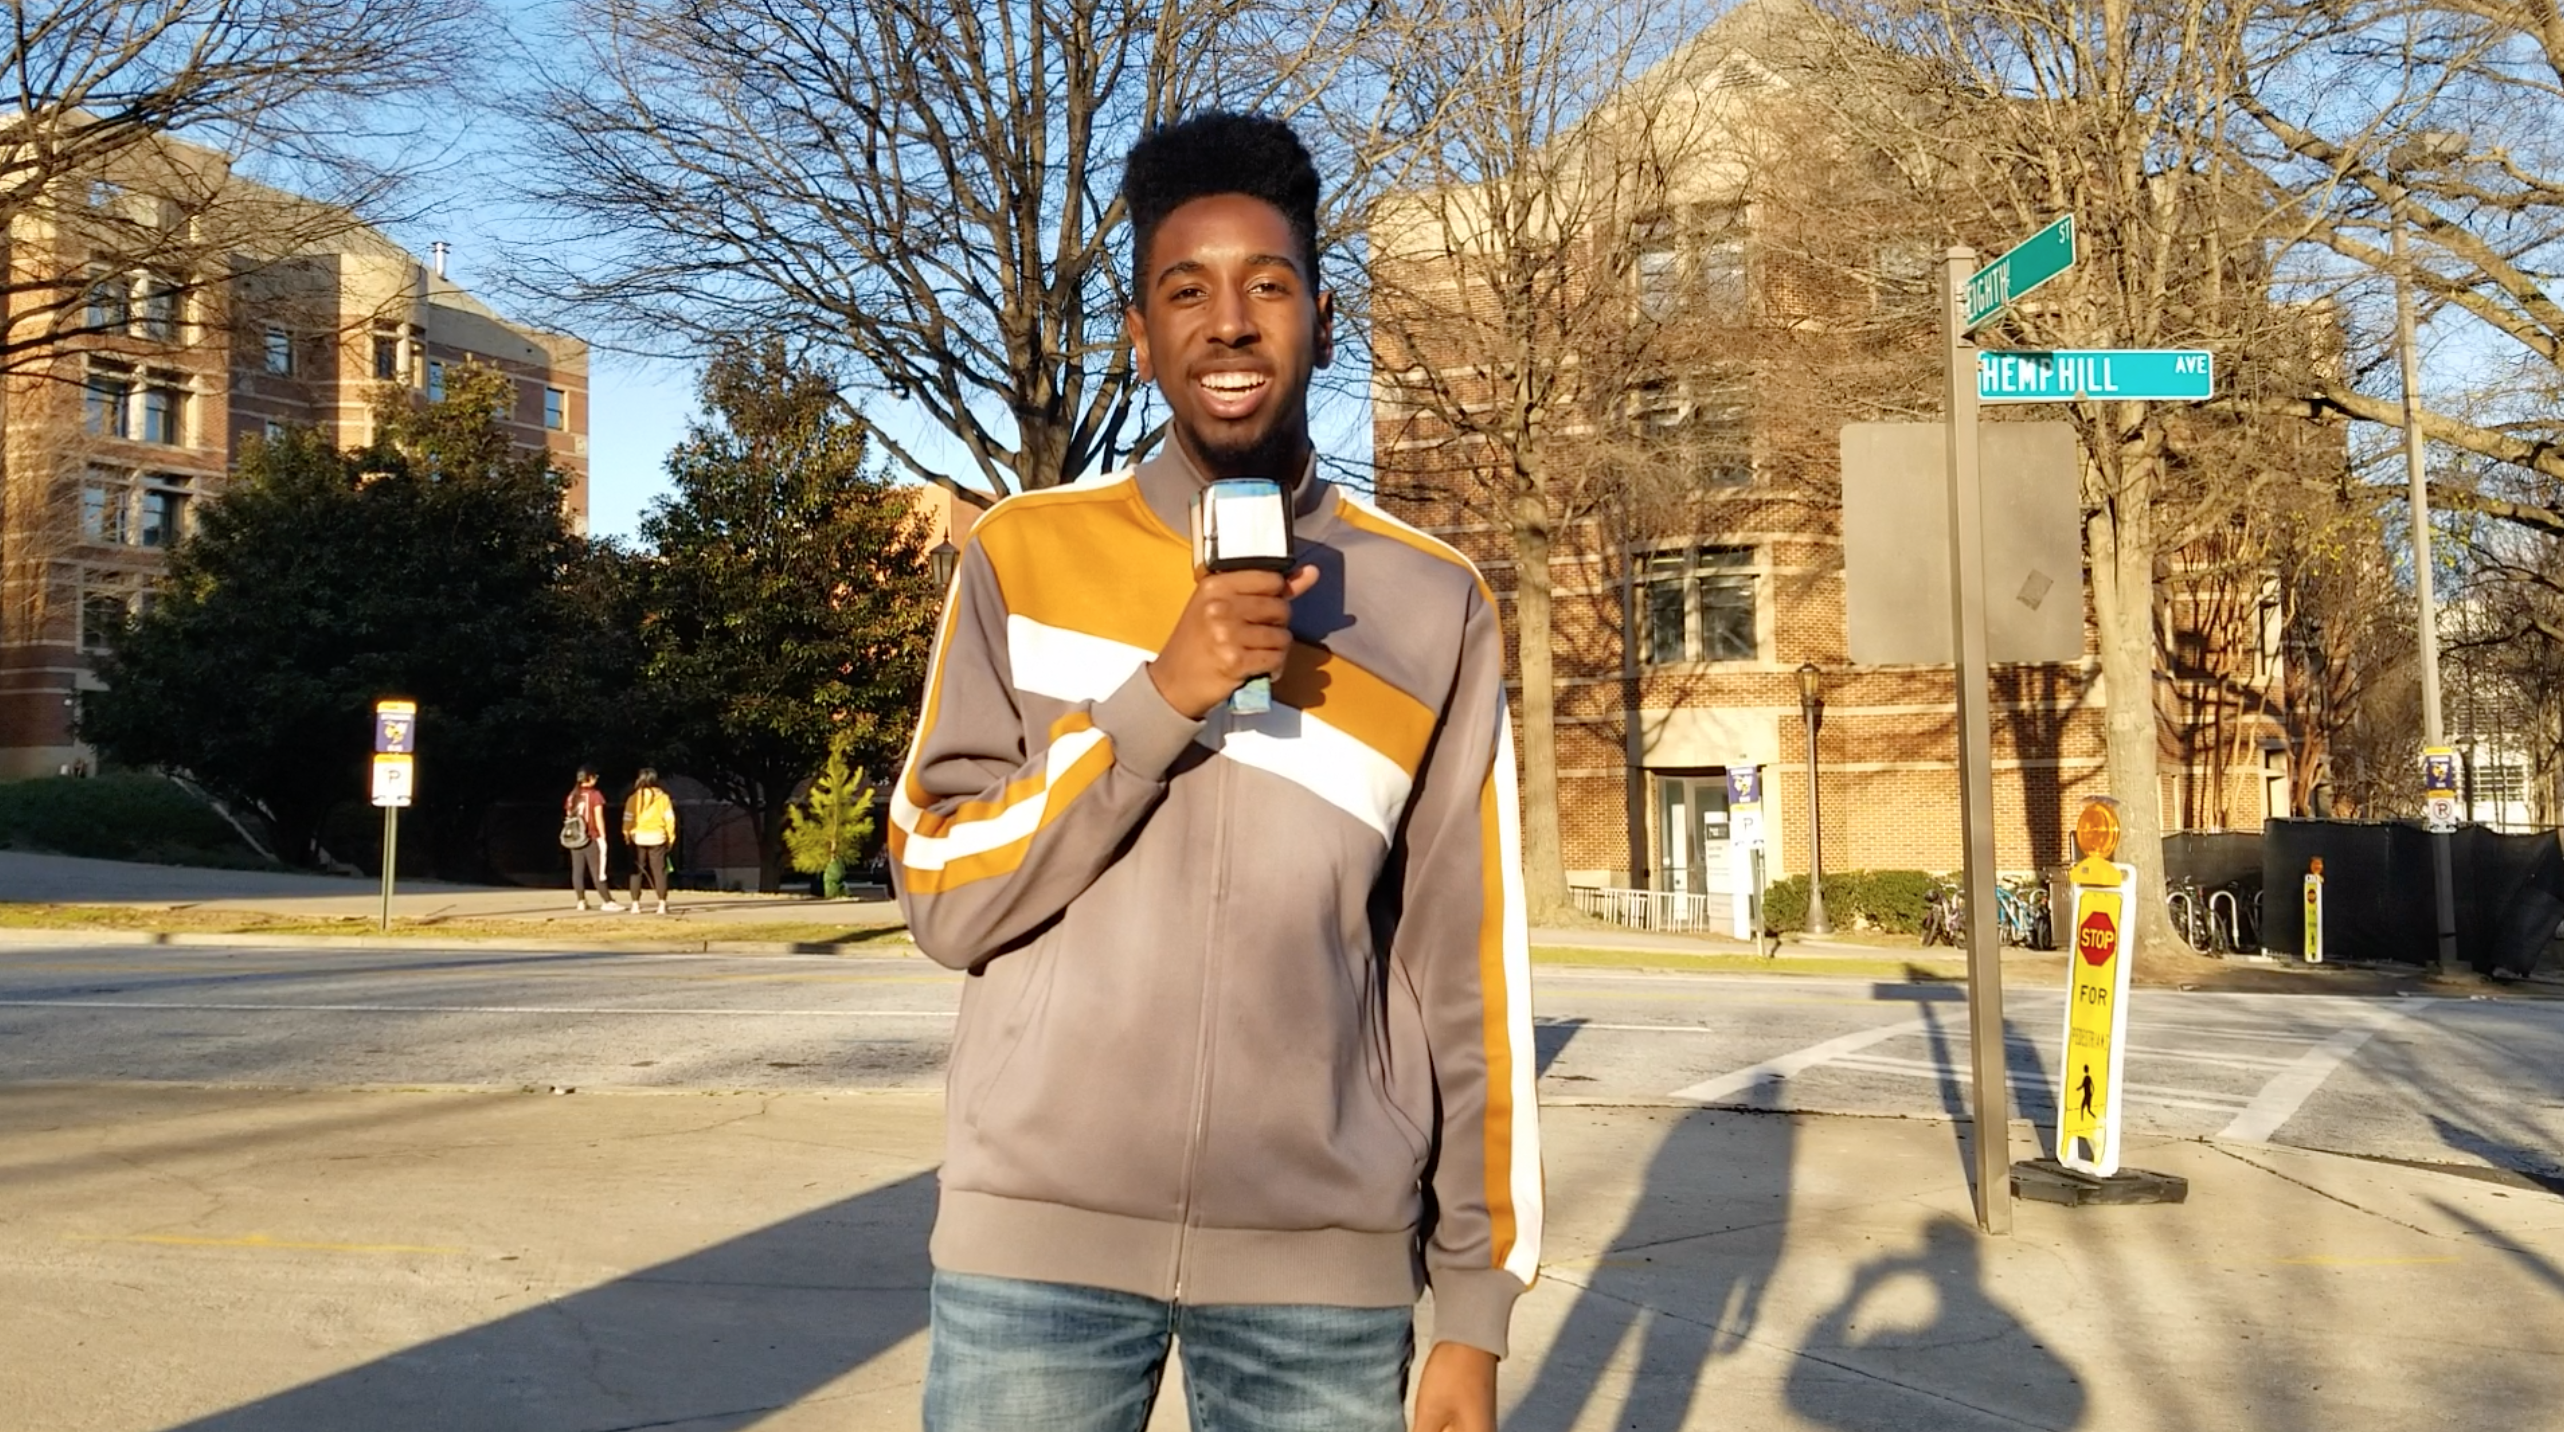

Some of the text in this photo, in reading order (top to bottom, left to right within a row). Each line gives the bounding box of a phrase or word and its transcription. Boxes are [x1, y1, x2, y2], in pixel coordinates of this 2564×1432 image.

[1966, 220, 2070, 319] EIGHTH ST
[1982, 355, 2207, 392] HEMPHILL AVE
[2081, 927, 2114, 950] STOP
[2079, 984, 2108, 1007] FOR
